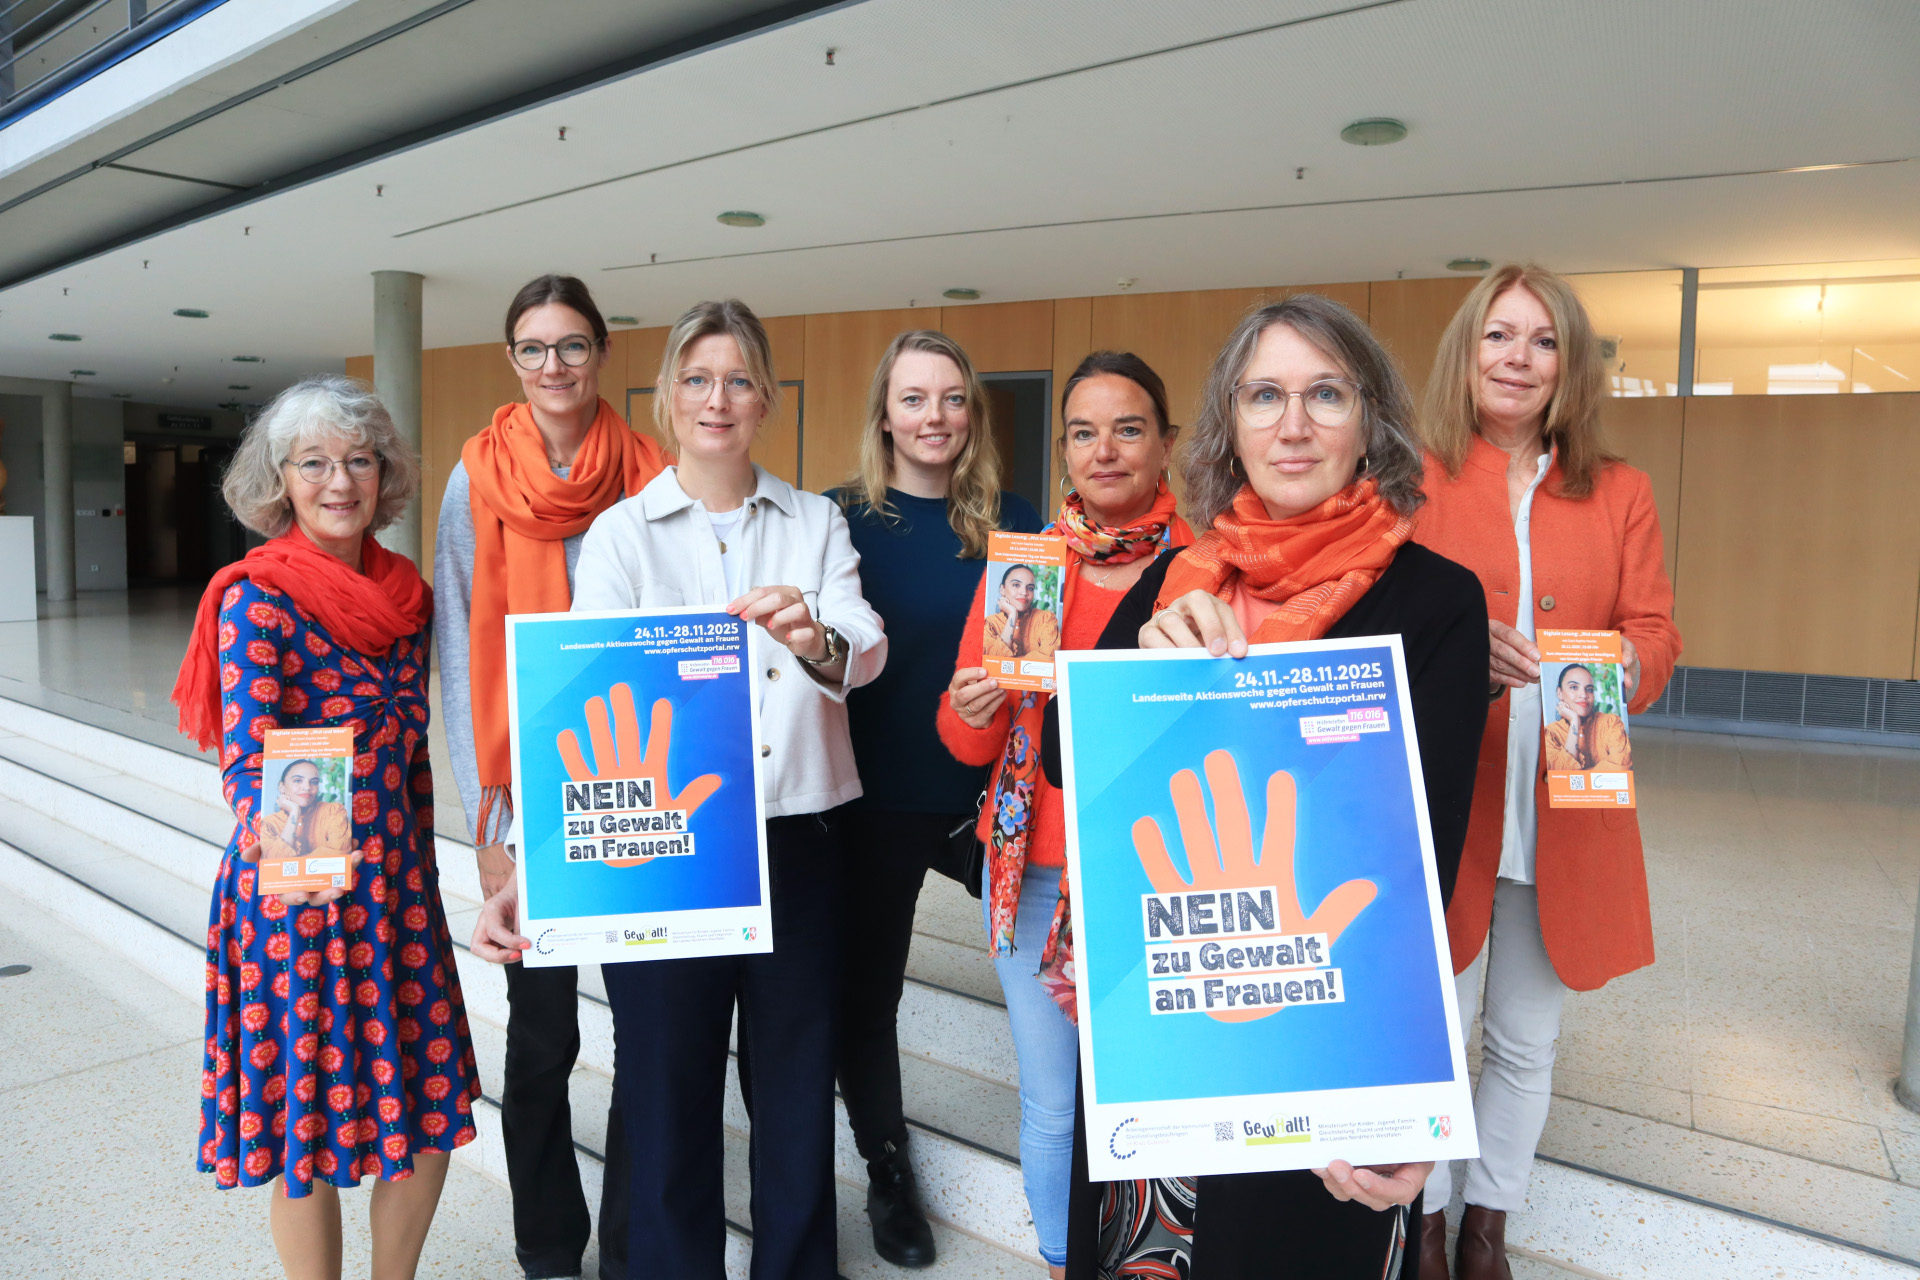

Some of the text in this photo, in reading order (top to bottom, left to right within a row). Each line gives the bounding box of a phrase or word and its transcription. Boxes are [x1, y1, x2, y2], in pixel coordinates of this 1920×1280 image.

[634, 623, 739, 639] 24.11.-28.11.2025
[560, 641, 605, 650] Landesweite
[605, 639, 655, 648] Aktionswoche
[643, 644, 740, 655] www.opferschutzportal.nrw
[1234, 662, 1383, 688] 24.11.-28.11.2025
[1132, 680, 1385, 703] Landesweite Aktionswoche gegen Gewalt an Frauen
[1249, 692, 1387, 709] www.opferschutzportal.nrw
[1350, 709, 1381, 721] 116 016
[1317, 722, 1386, 733] Gewalt gegen Frauen
[565, 779, 652, 812] NEIN
[568, 811, 683, 836] zu Gewalt
[569, 834, 690, 860] an Frauen!
[1146, 889, 1275, 938] NEIN
[1151, 936, 1323, 975] zu Gewalt
[1155, 971, 1337, 1012] an Frauen!
